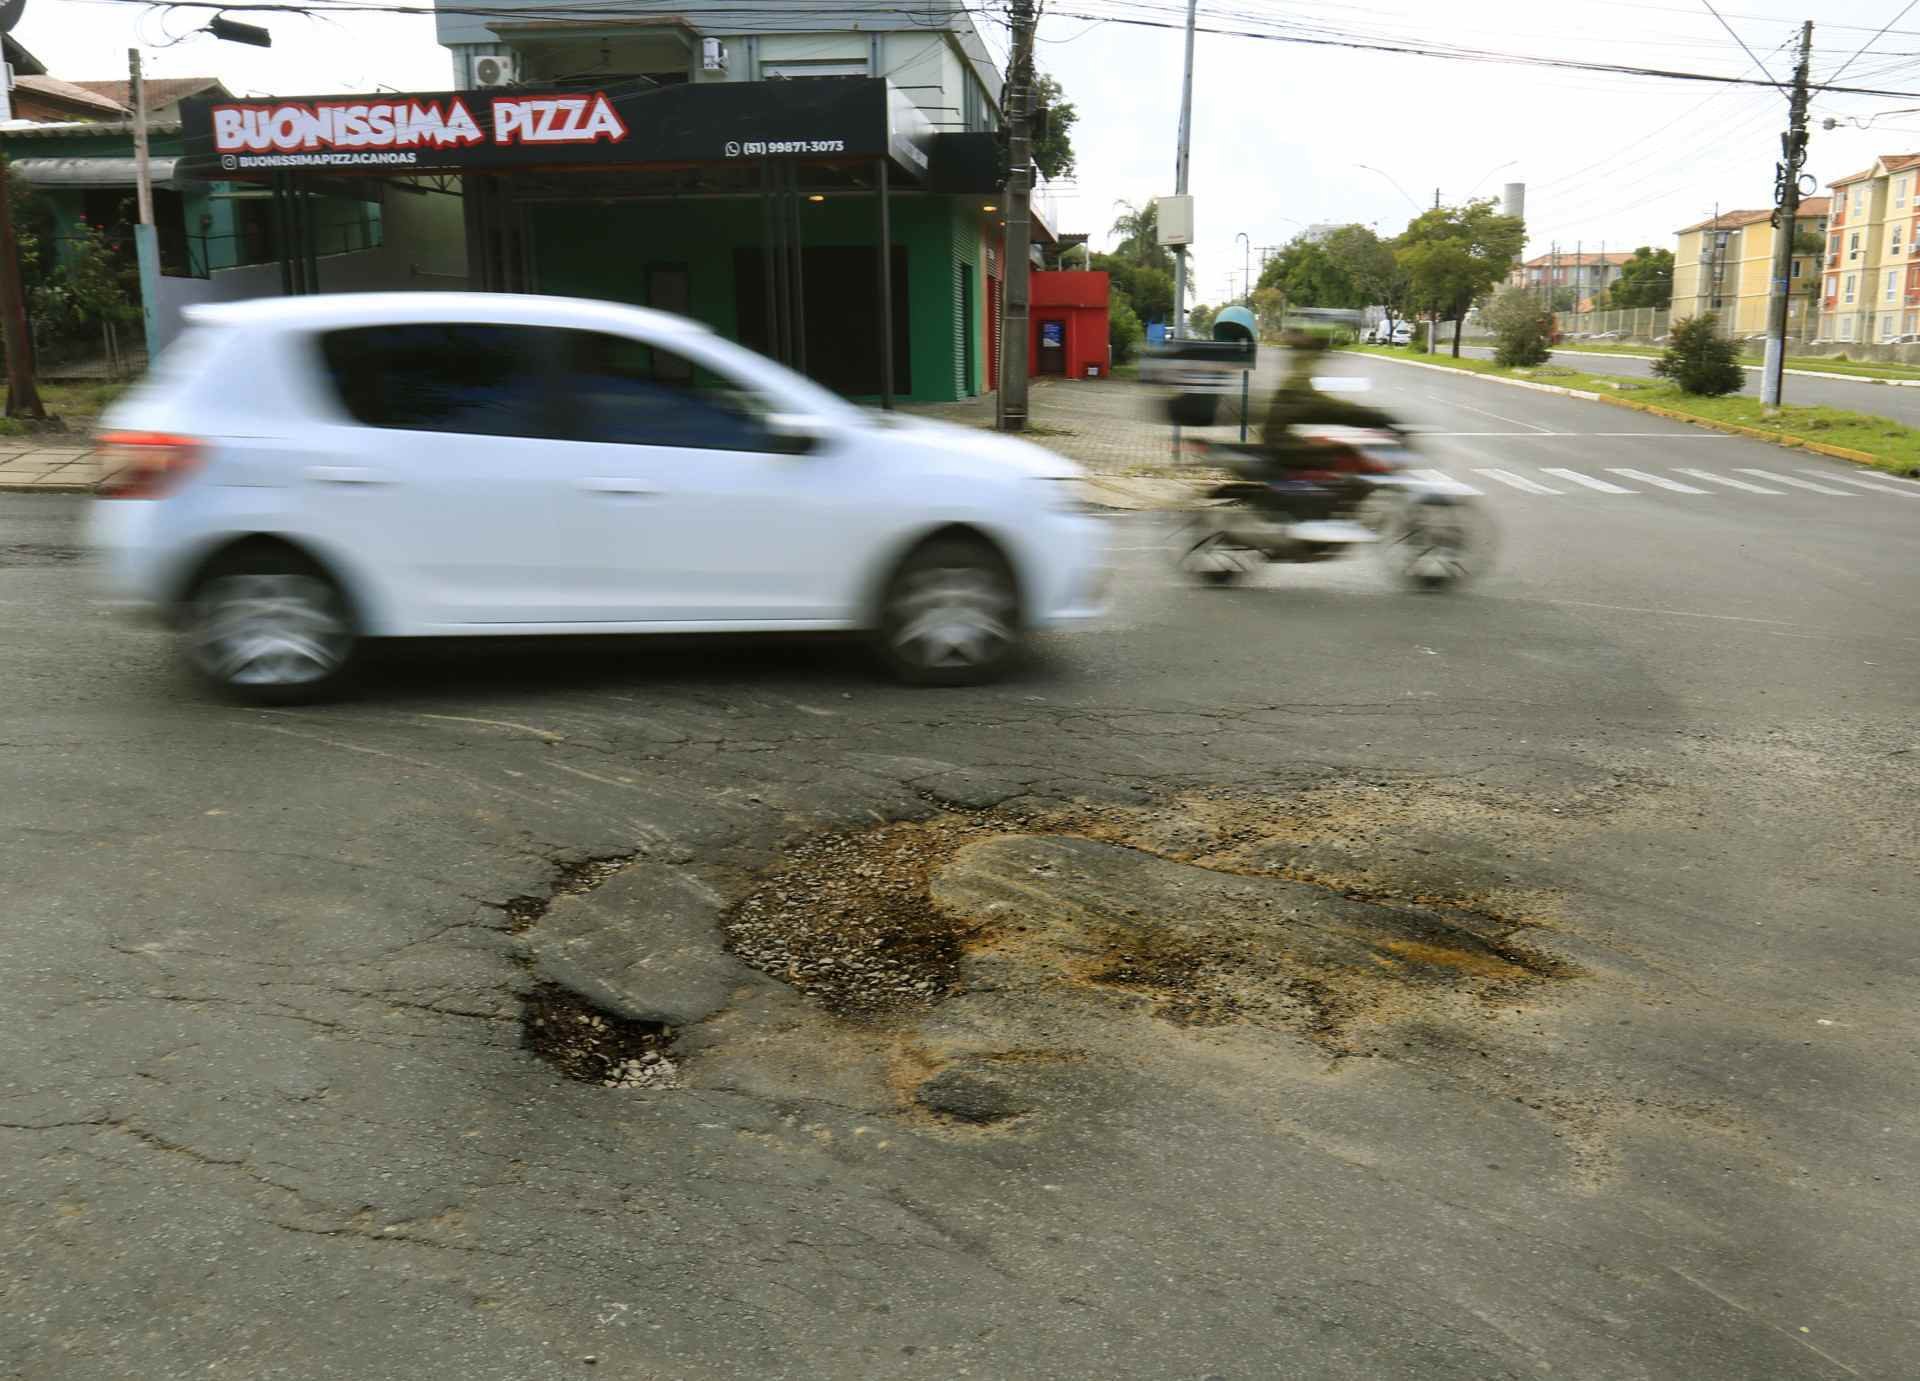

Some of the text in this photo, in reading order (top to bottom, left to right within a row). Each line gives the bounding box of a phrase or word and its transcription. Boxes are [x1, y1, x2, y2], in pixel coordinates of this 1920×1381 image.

[213, 98, 624, 149] BUONISSIMA PIZZA
[743, 140, 844, 155] (51) 99871-3073
[240, 152, 417, 167] BUONISSIMAPIZZACANOAS
